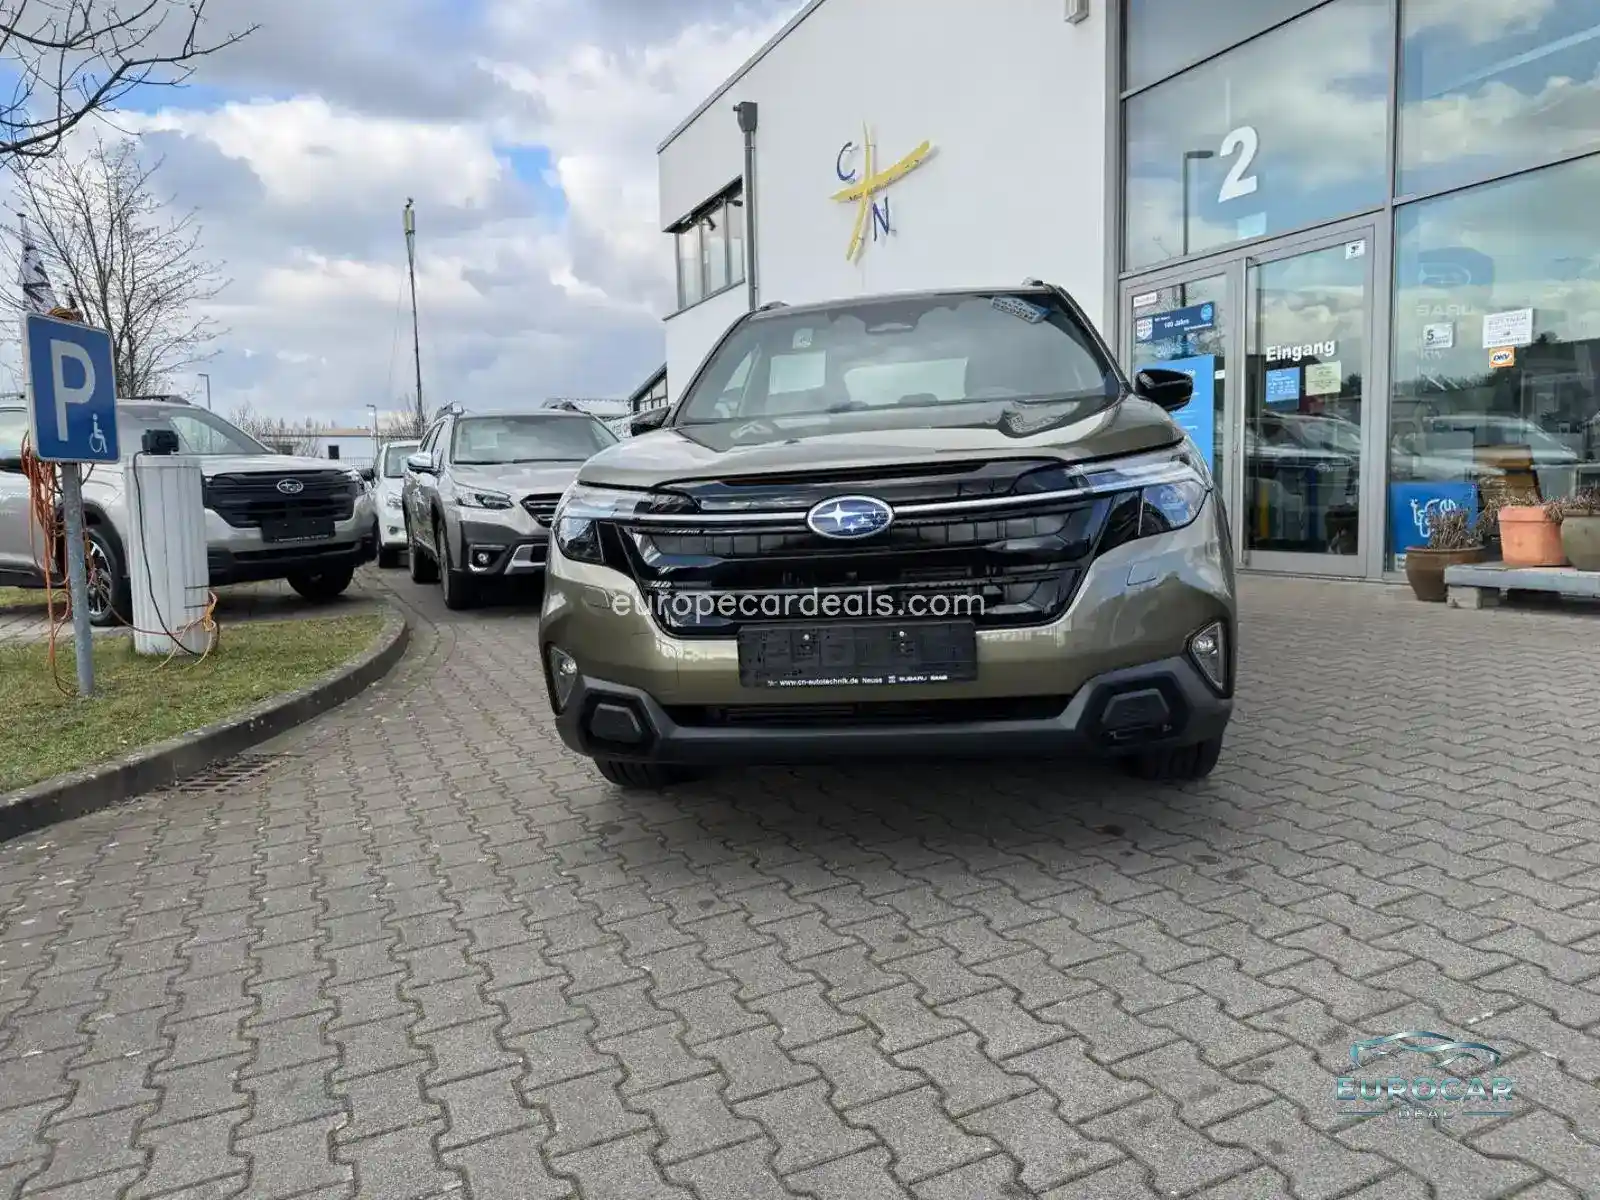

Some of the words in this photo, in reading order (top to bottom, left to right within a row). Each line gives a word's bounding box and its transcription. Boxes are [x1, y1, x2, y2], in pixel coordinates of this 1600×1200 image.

[836, 141, 855, 181] C
[1218, 126, 1257, 203] 2
[872, 196, 890, 241] N
[1265, 340, 1335, 362] Eingang
[1426, 328, 1435, 341] 5
[50, 338, 96, 441] P
[779, 677, 859, 687] www.cn-autotechnik.de
